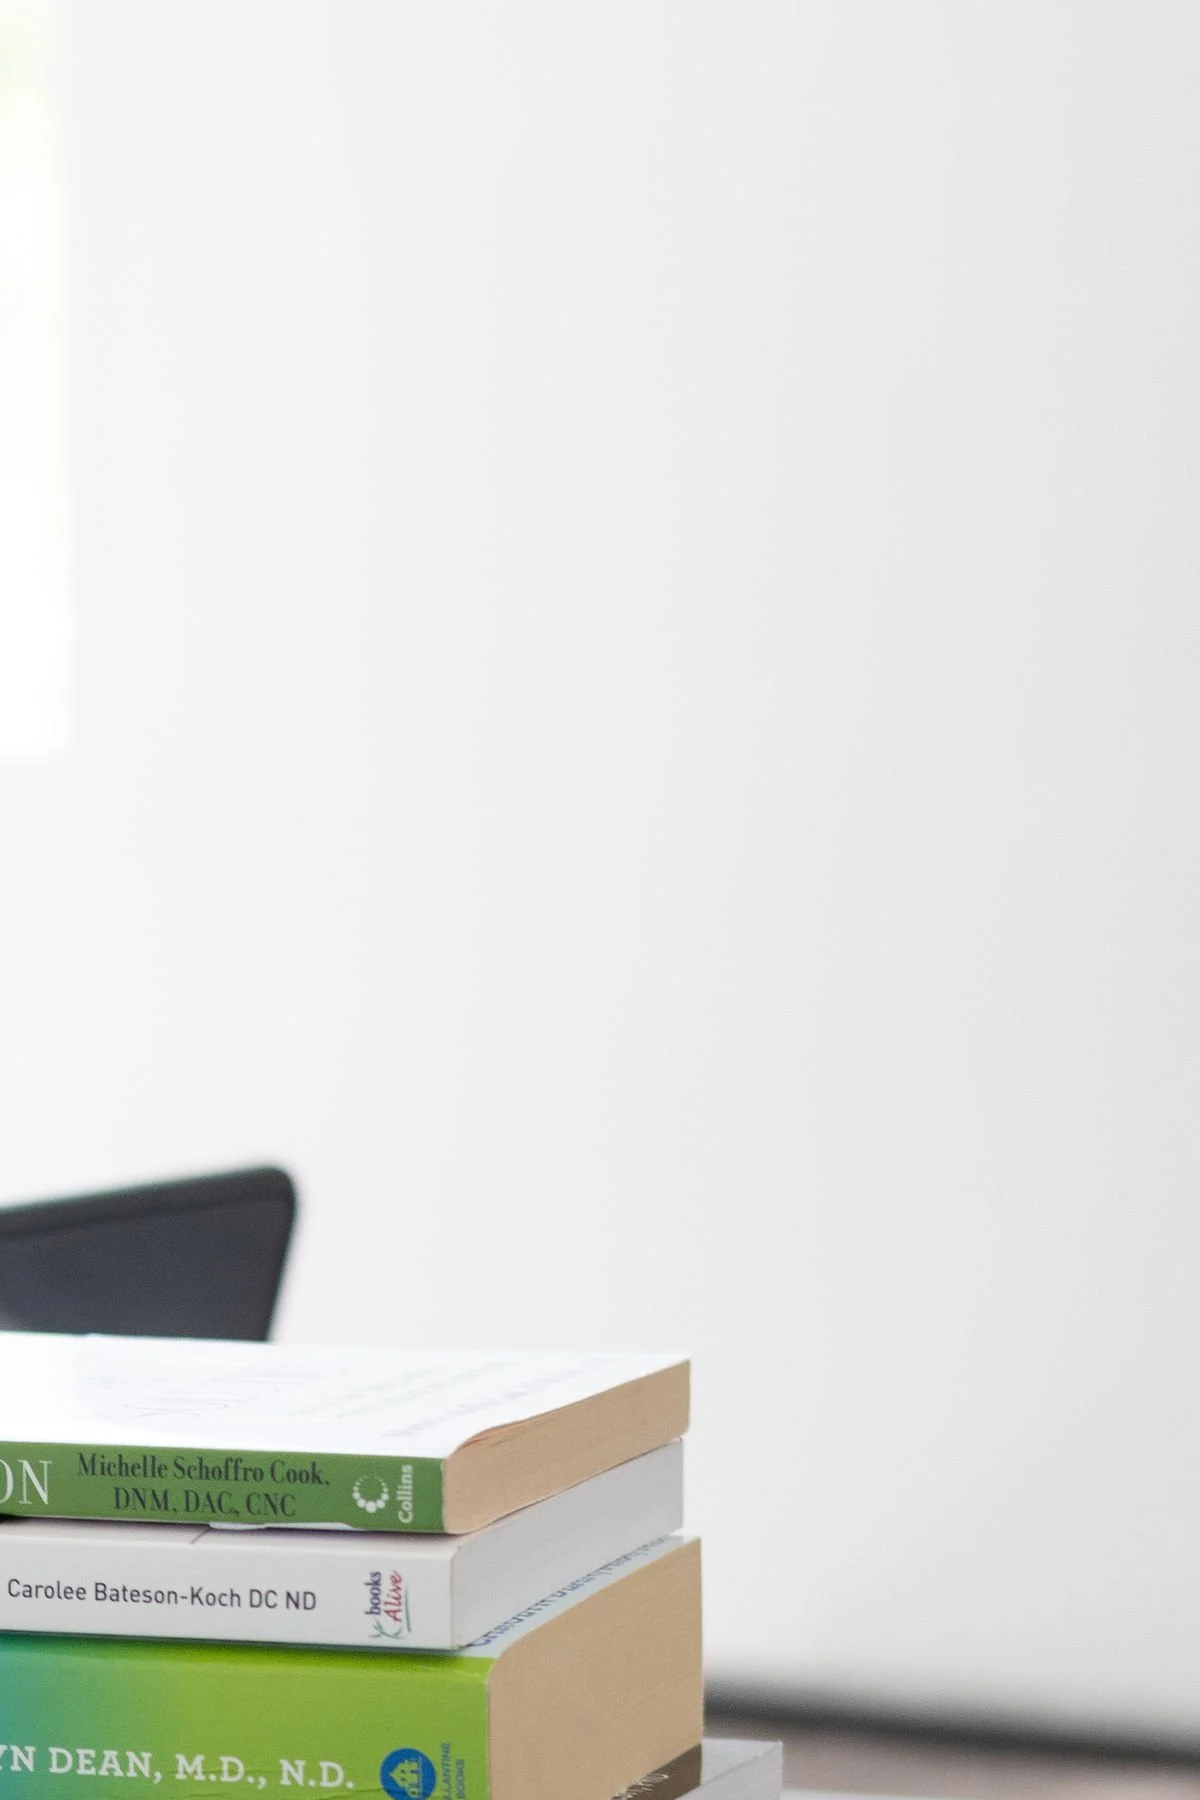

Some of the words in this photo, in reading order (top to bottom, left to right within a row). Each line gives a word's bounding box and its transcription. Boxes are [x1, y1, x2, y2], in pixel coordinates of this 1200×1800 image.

[78, 1452, 168, 1479] Michelle
[173, 1456, 264, 1484] Schoffro
[270, 1460, 331, 1487] Cook,
[114, 1488, 178, 1514] DNM,
[183, 1490, 240, 1516] DAC,
[246, 1492, 296, 1517] CNC
[398, 1464, 414, 1524] Collins
[7, 1579, 86, 1602] Carolee
[94, 1582, 242, 1608] Bateson-Koch
[250, 1587, 279, 1609] DC
[286, 1588, 317, 1611] ND
[365, 1571, 381, 1615] books
[385, 1570, 403, 1622] Alive
[48, 1747, 163, 1783] DEAN,
[174, 1754, 267, 1788] M.D.,
[280, 1760, 354, 1790] N.D.
